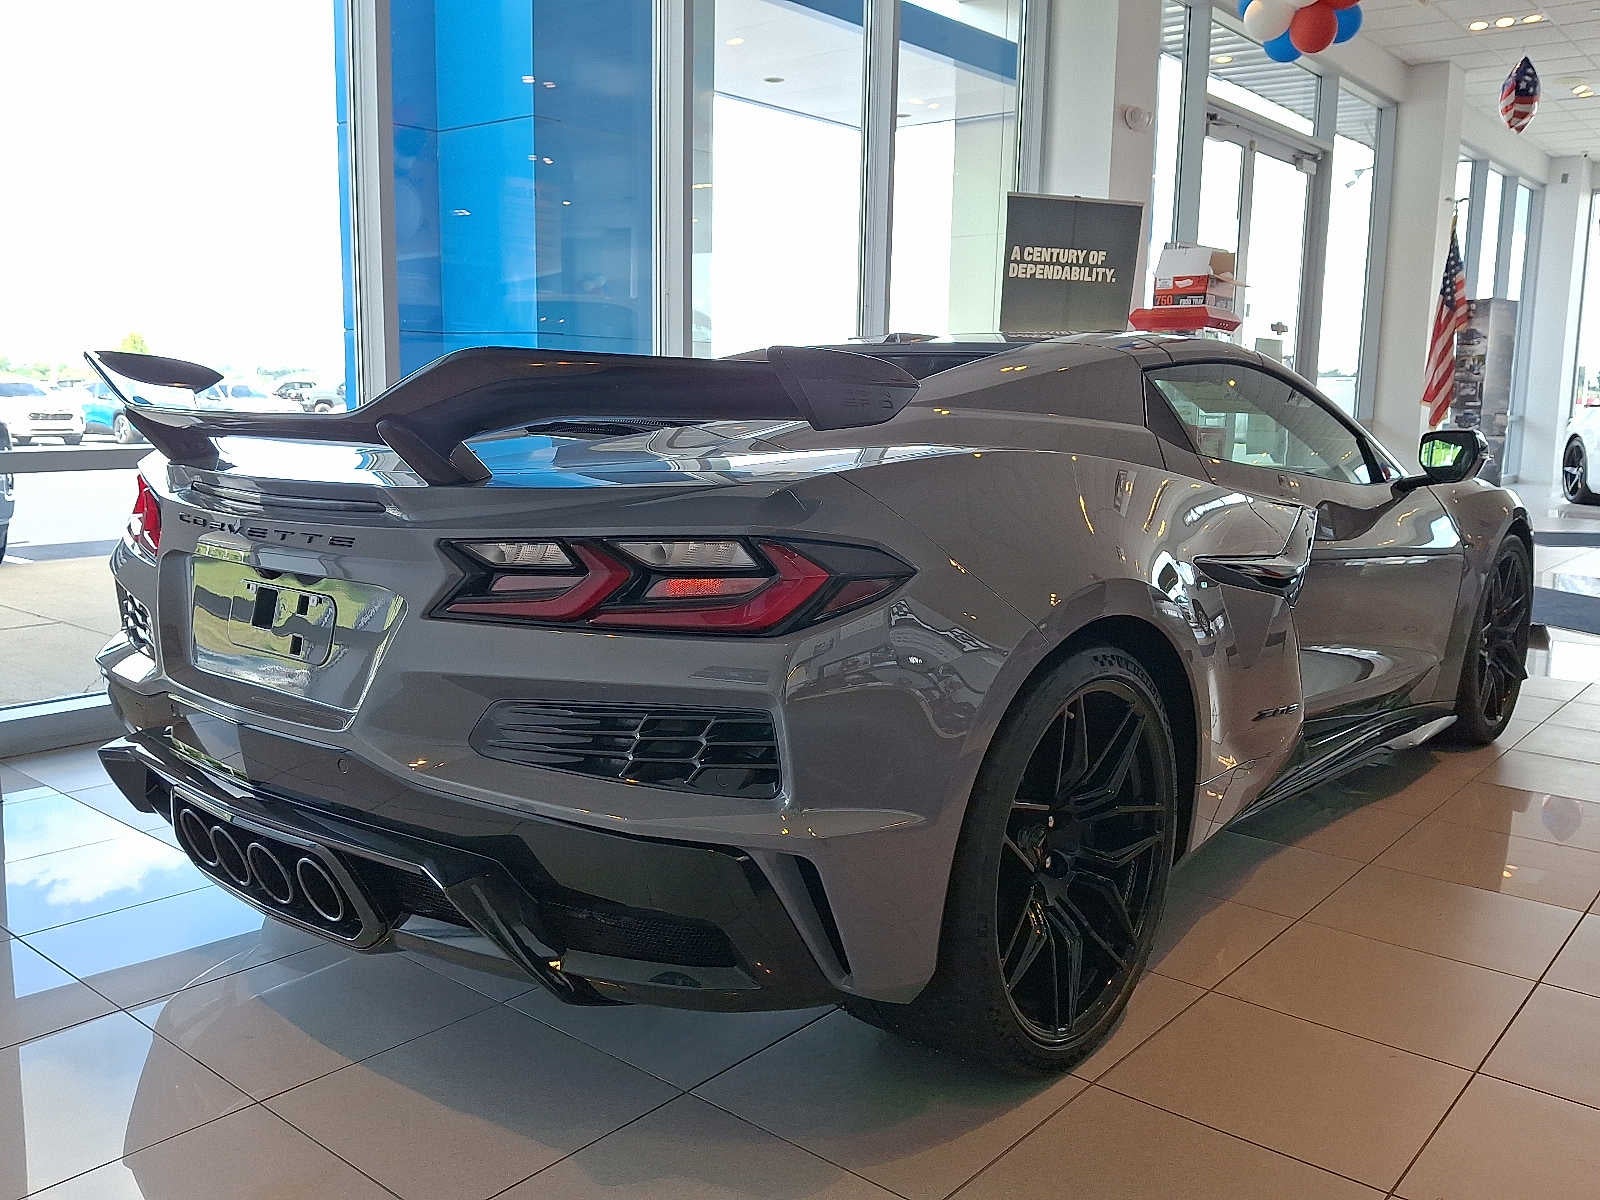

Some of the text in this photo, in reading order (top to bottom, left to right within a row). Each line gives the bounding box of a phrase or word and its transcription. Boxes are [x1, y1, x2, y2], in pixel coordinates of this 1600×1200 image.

[1011, 245, 1107, 266] A CENTURY OF
[1008, 262, 1117, 283] DEPENDABILITY.
[1155, 294, 1173, 306] 750
[178, 511, 356, 548] CORVETTE
